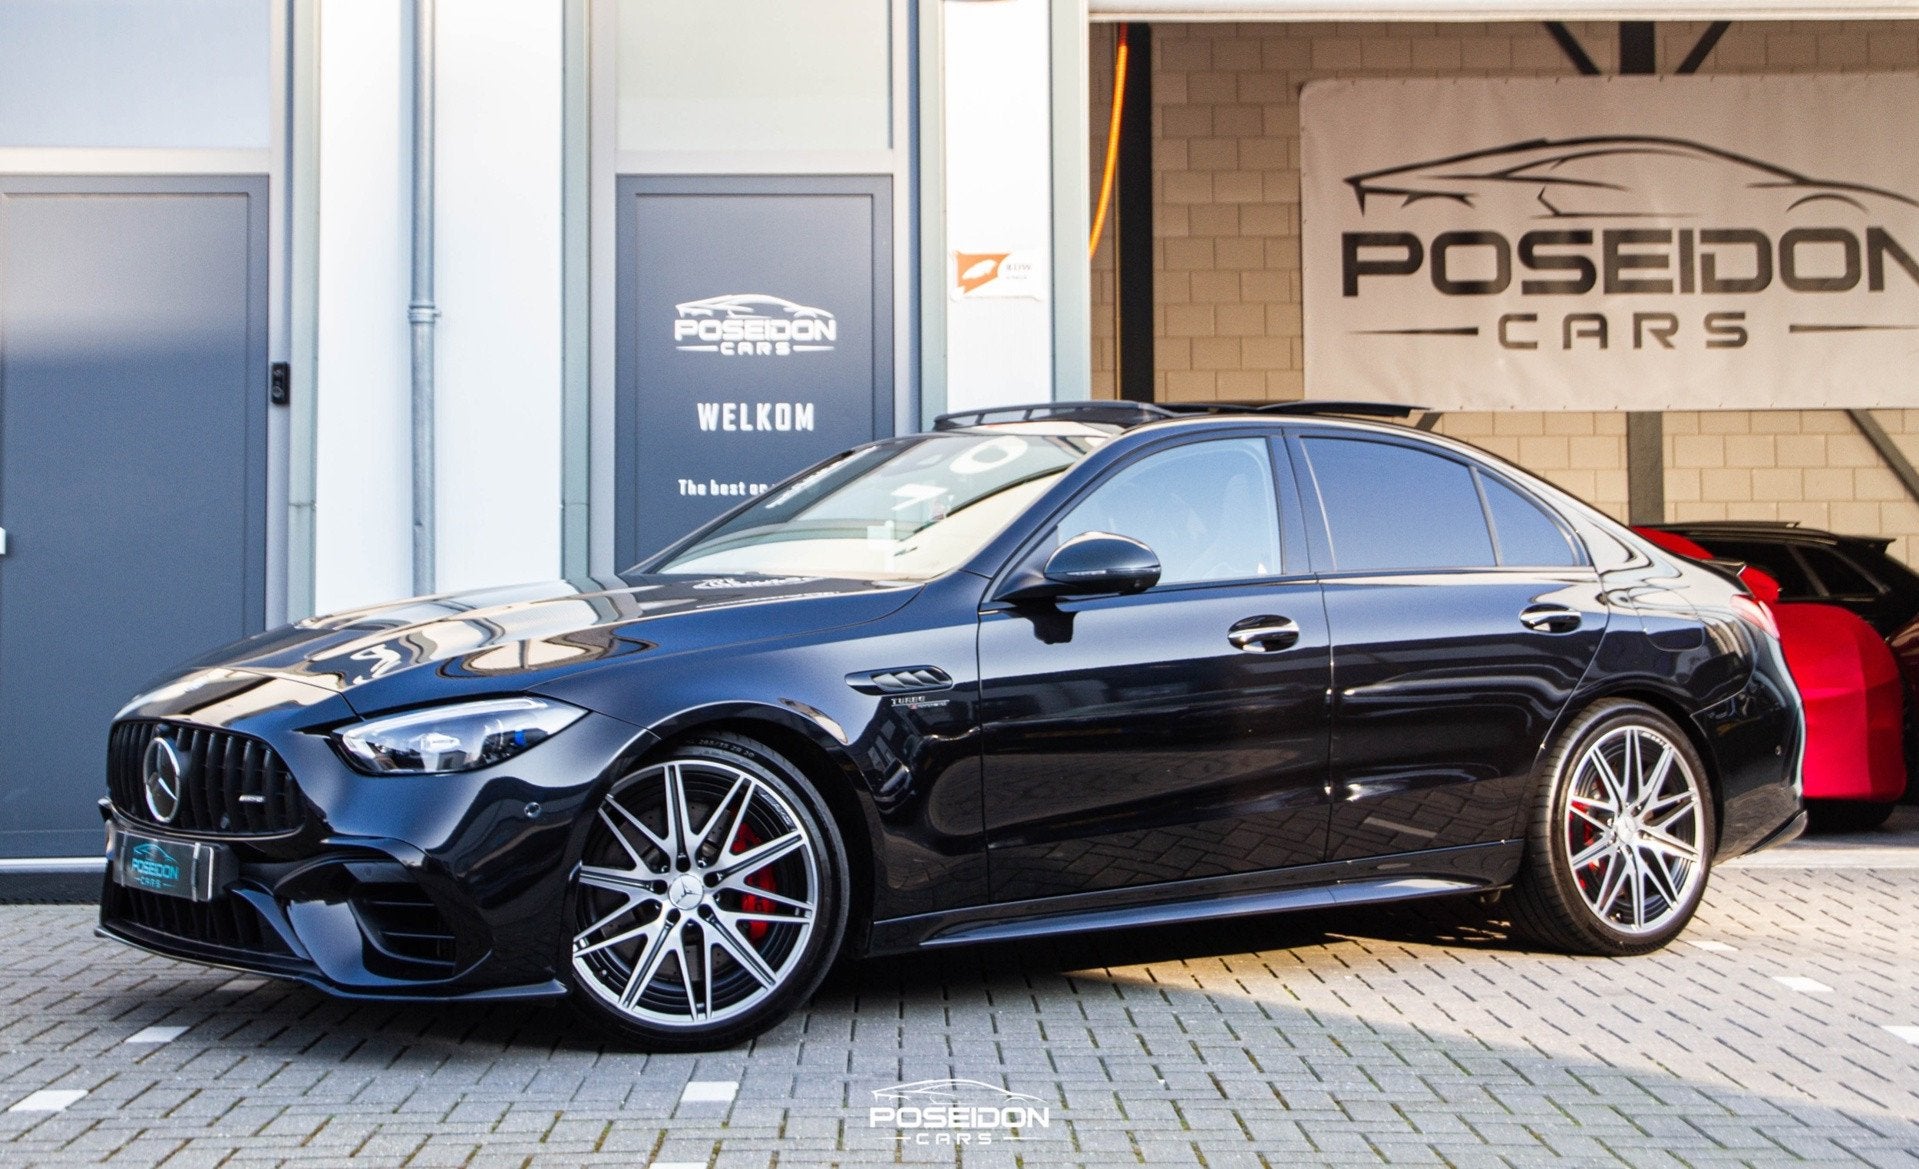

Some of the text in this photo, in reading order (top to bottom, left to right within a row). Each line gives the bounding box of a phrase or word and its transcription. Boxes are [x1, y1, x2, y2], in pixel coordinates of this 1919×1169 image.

[1341, 226, 1919, 297] POSEIDON
[674, 319, 837, 341] POSEIDON
[1498, 311, 1748, 350] CARS
[720, 341, 791, 356] CARS
[697, 402, 815, 431] WELKOM
[677, 479, 706, 496] The
[710, 479, 746, 496] best
[132, 857, 180, 880] POSEIDON
